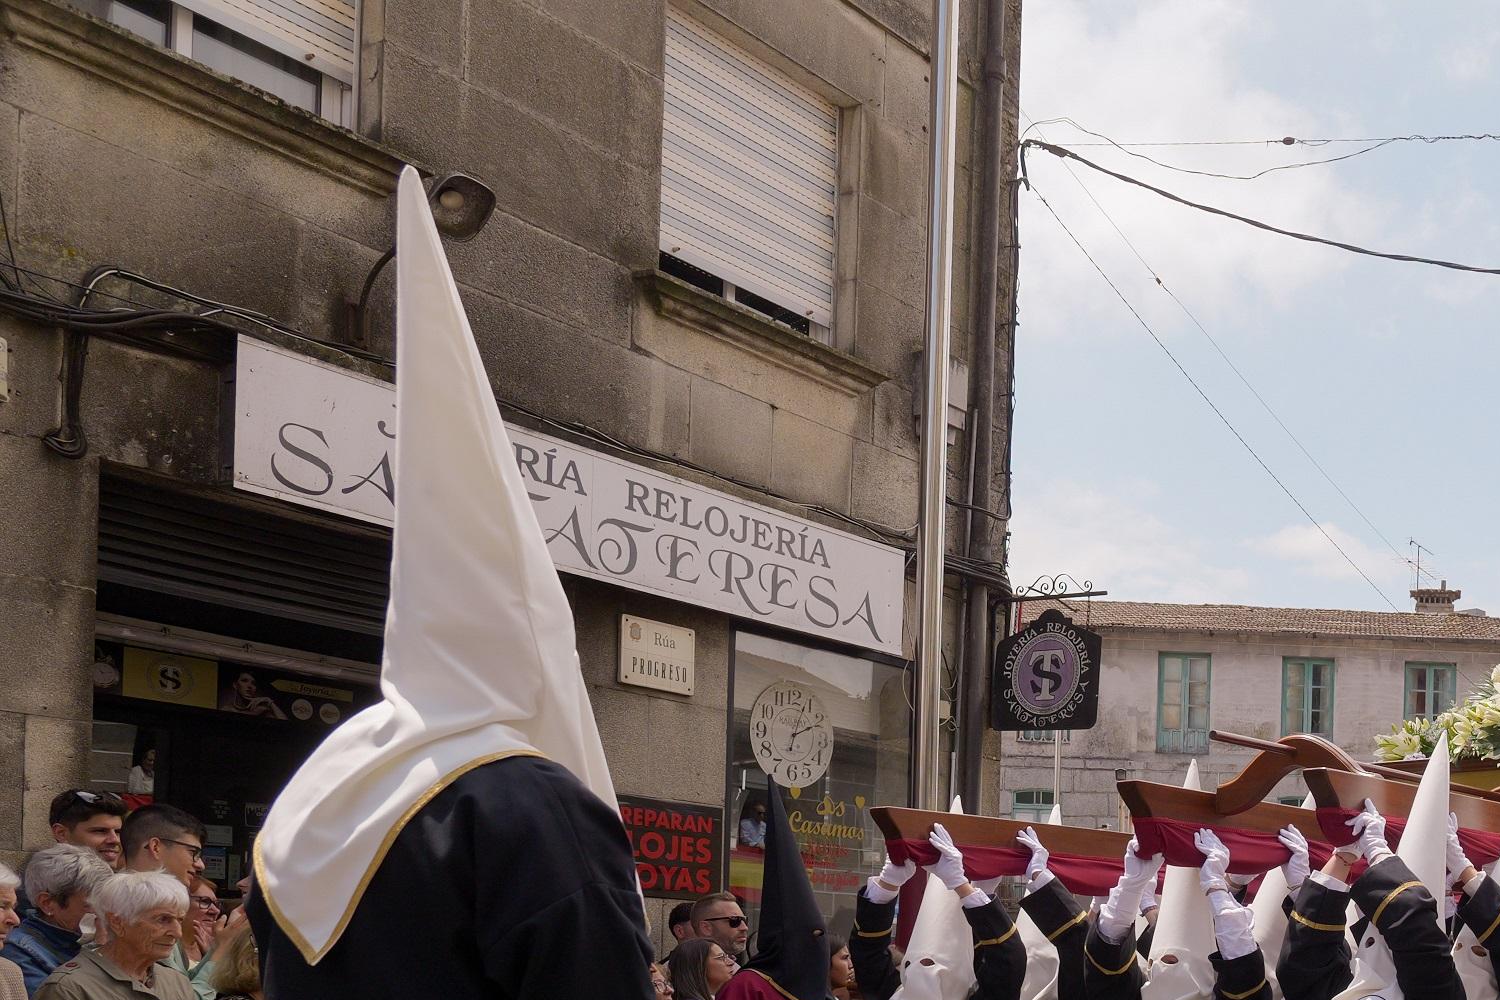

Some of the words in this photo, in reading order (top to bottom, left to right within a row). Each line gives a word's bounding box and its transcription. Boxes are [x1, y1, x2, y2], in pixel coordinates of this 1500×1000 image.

[624, 478, 831, 569] RELOJERÍA
[654, 631, 676, 649] Rúa
[1003, 628, 1038, 679] JOYERÍA
[1046, 622, 1092, 674] RELOJERÍA
[632, 656, 687, 683] PROGRESO
[620, 806, 713, 834] REPARAN
[788, 810, 865, 840] Casamos
[635, 863, 711, 894] OYAS
